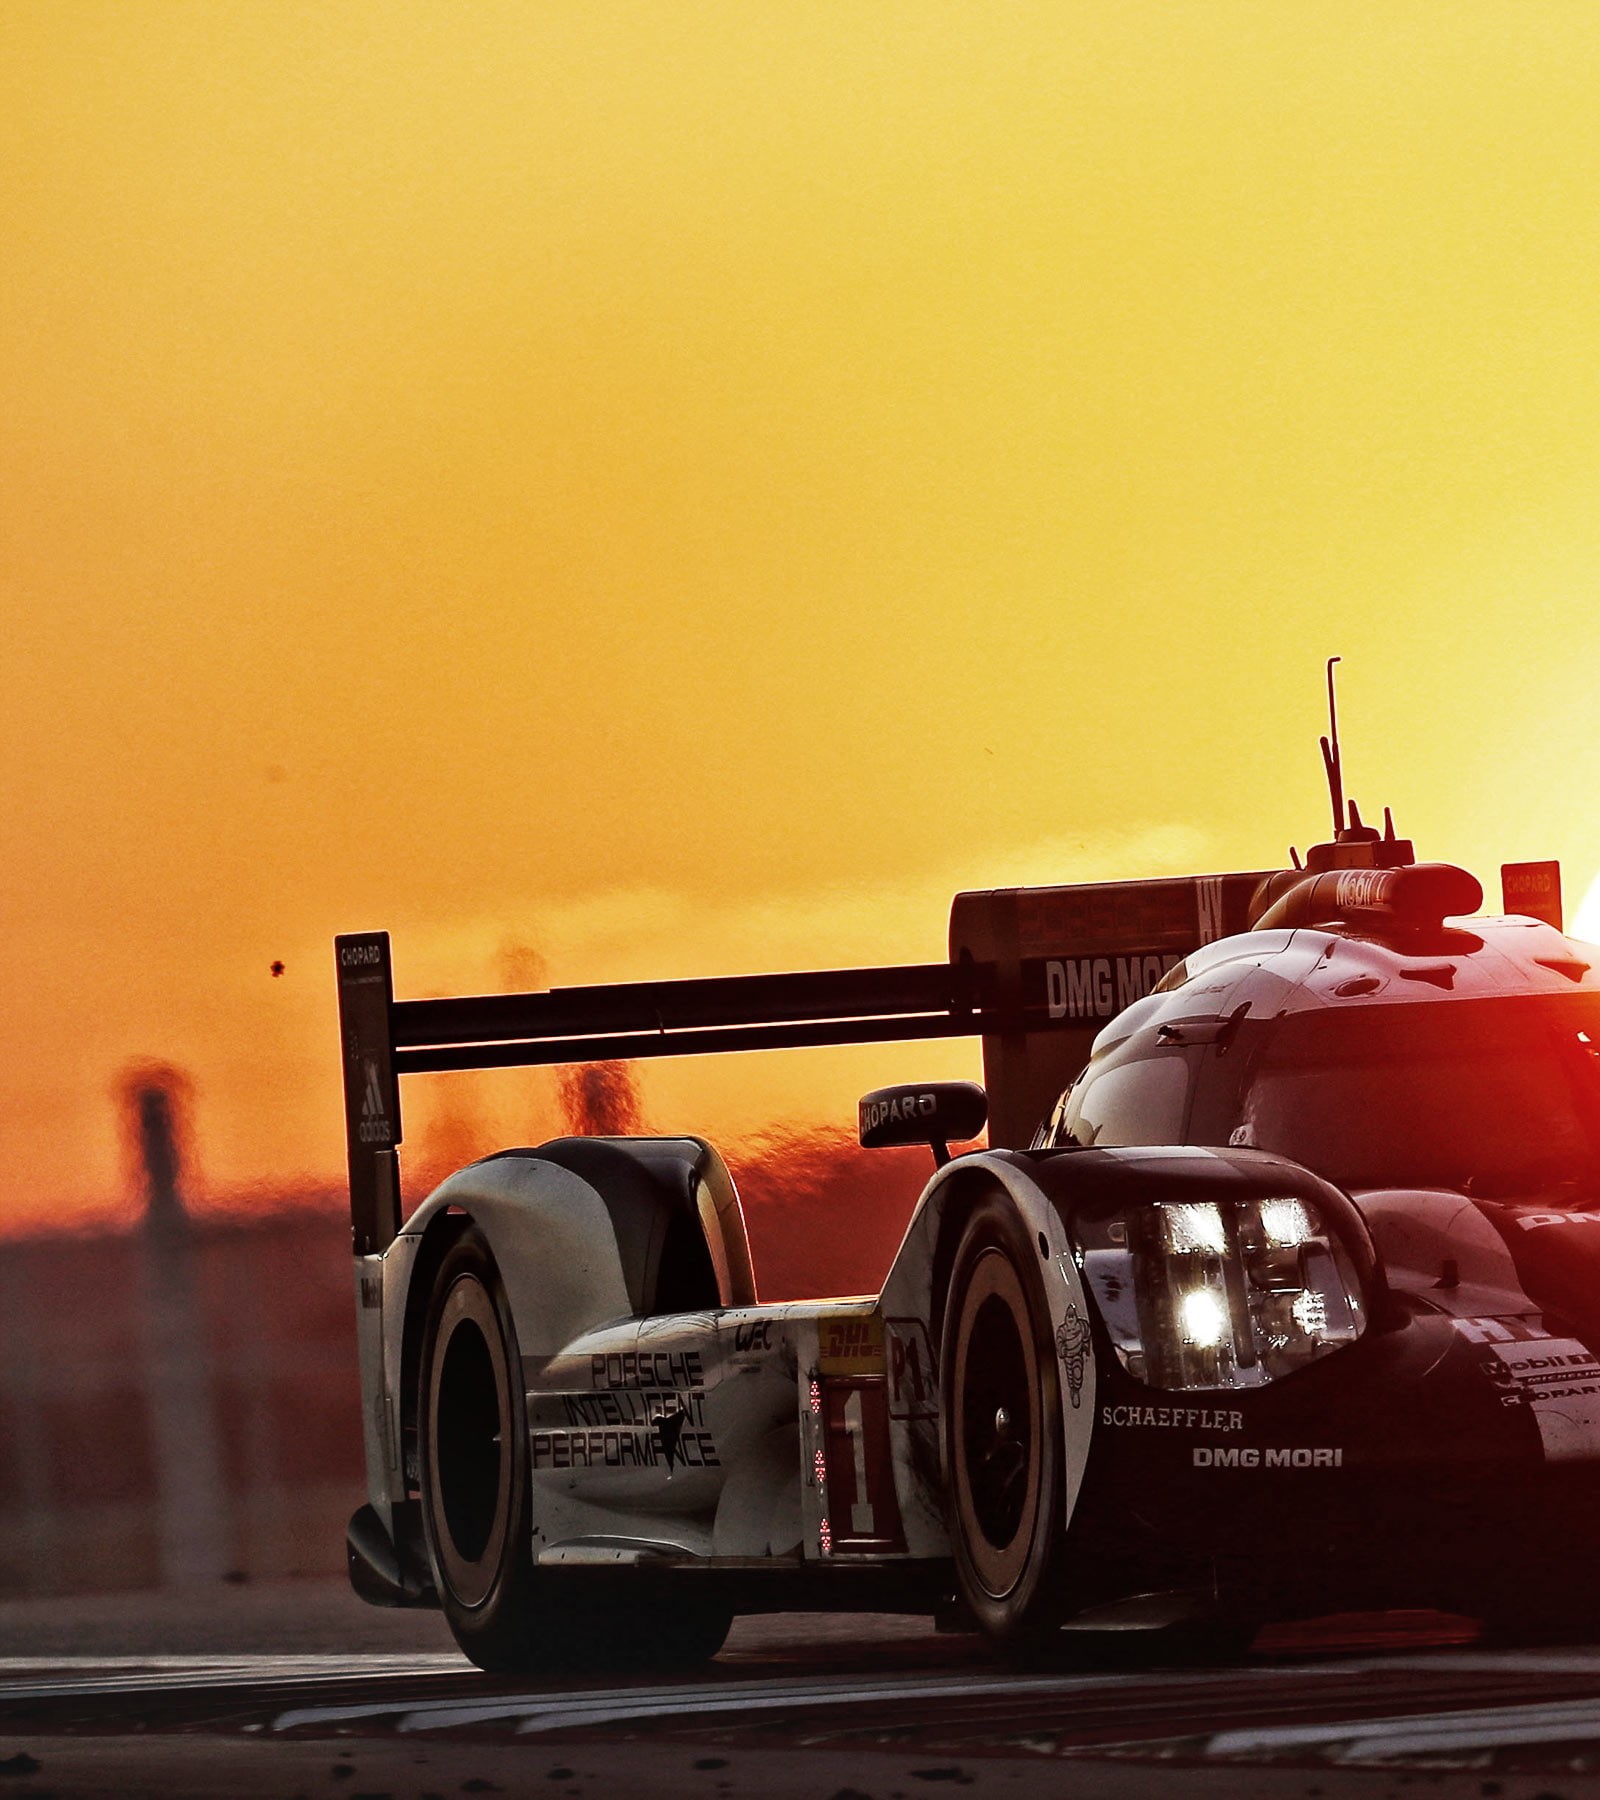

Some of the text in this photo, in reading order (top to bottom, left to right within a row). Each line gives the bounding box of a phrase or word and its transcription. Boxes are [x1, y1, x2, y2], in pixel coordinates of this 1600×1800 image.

[1336, 869, 1380, 906] Mobil
[1506, 873, 1551, 894] CHOPARD
[341, 945, 381, 967] CHOPARD
[1046, 958, 1112, 1019] DMG
[360, 1114, 391, 1142] adidas
[828, 1323, 871, 1358] DHL
[591, 1352, 704, 1387] PORSCHE
[1480, 1355, 1566, 1376] Mobil
[1103, 1406, 1244, 1431] SCHAEFFLER
[533, 1432, 722, 1468] PERFORMANCE
[844, 1389, 875, 1534] 1
[1193, 1447, 1343, 1468] DMG MORI
